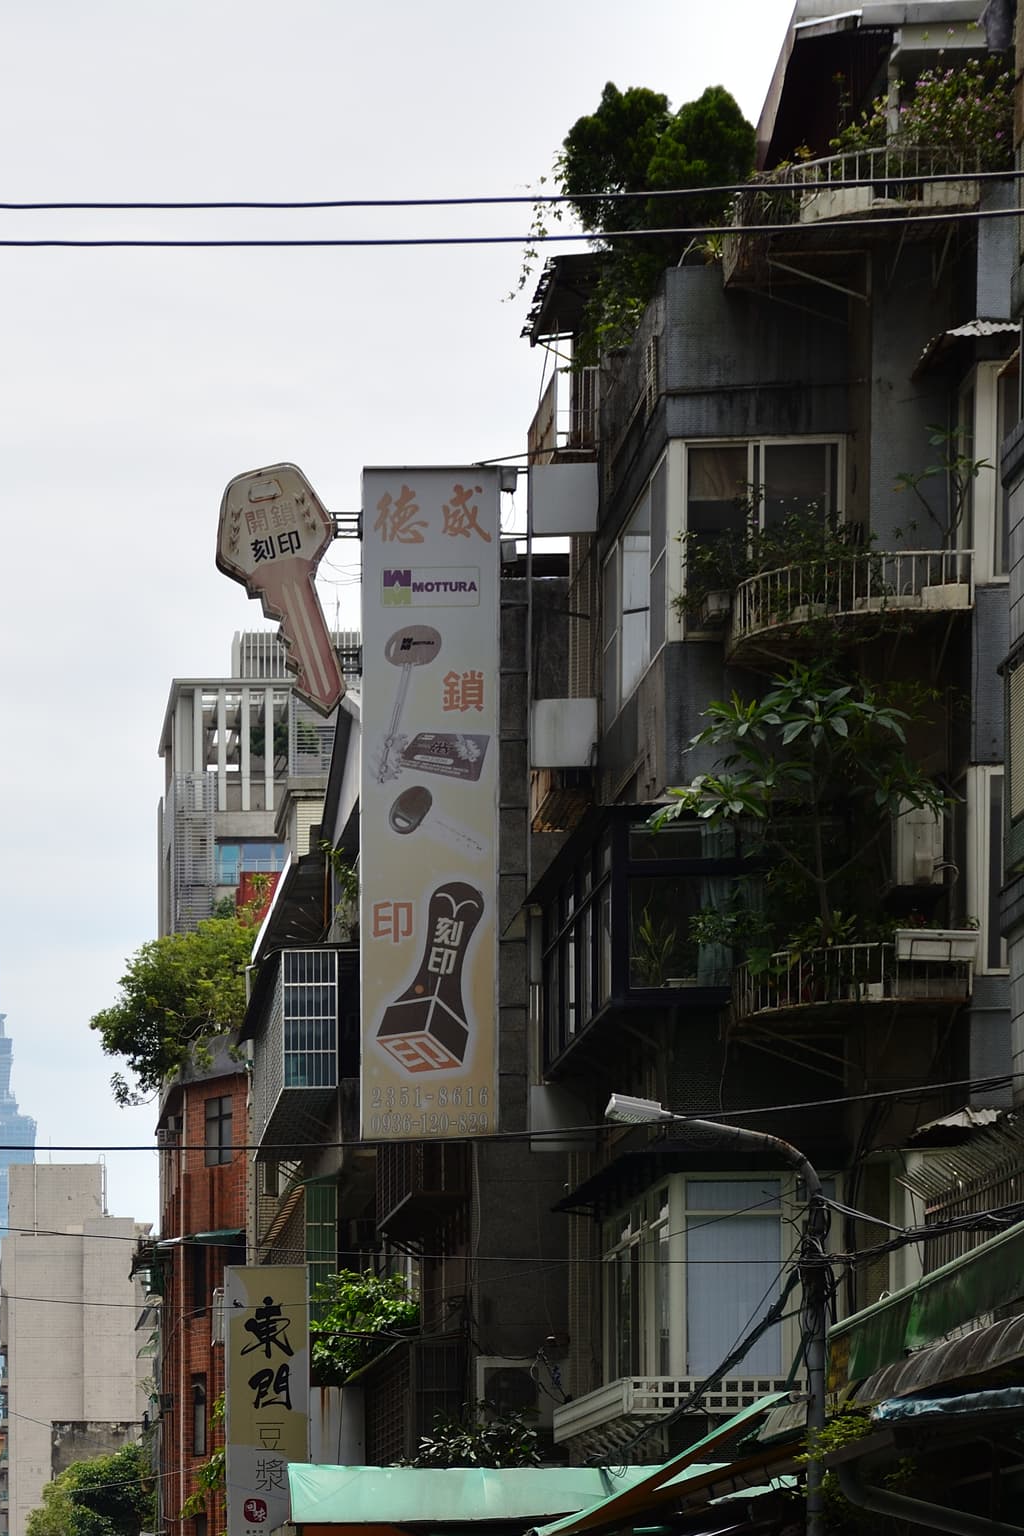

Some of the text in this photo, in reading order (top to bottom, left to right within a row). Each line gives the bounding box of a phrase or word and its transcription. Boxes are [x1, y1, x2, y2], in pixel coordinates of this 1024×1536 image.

[244, 502, 297, 535] 開鎖
[374, 484, 492, 544] 德威
[251, 530, 301, 562] 刻印
[412, 581, 478, 593] MOTTURA
[442, 670, 485, 713] 鎖
[372, 901, 414, 943] 印
[427, 916, 464, 975] 刻印
[371, 1086, 489, 1108] 2351-8616
[370, 1111, 489, 1134] 0936-120-829
[240, 1296, 295, 1411] 東門
[255, 1422, 287, 1492] 豆漿
